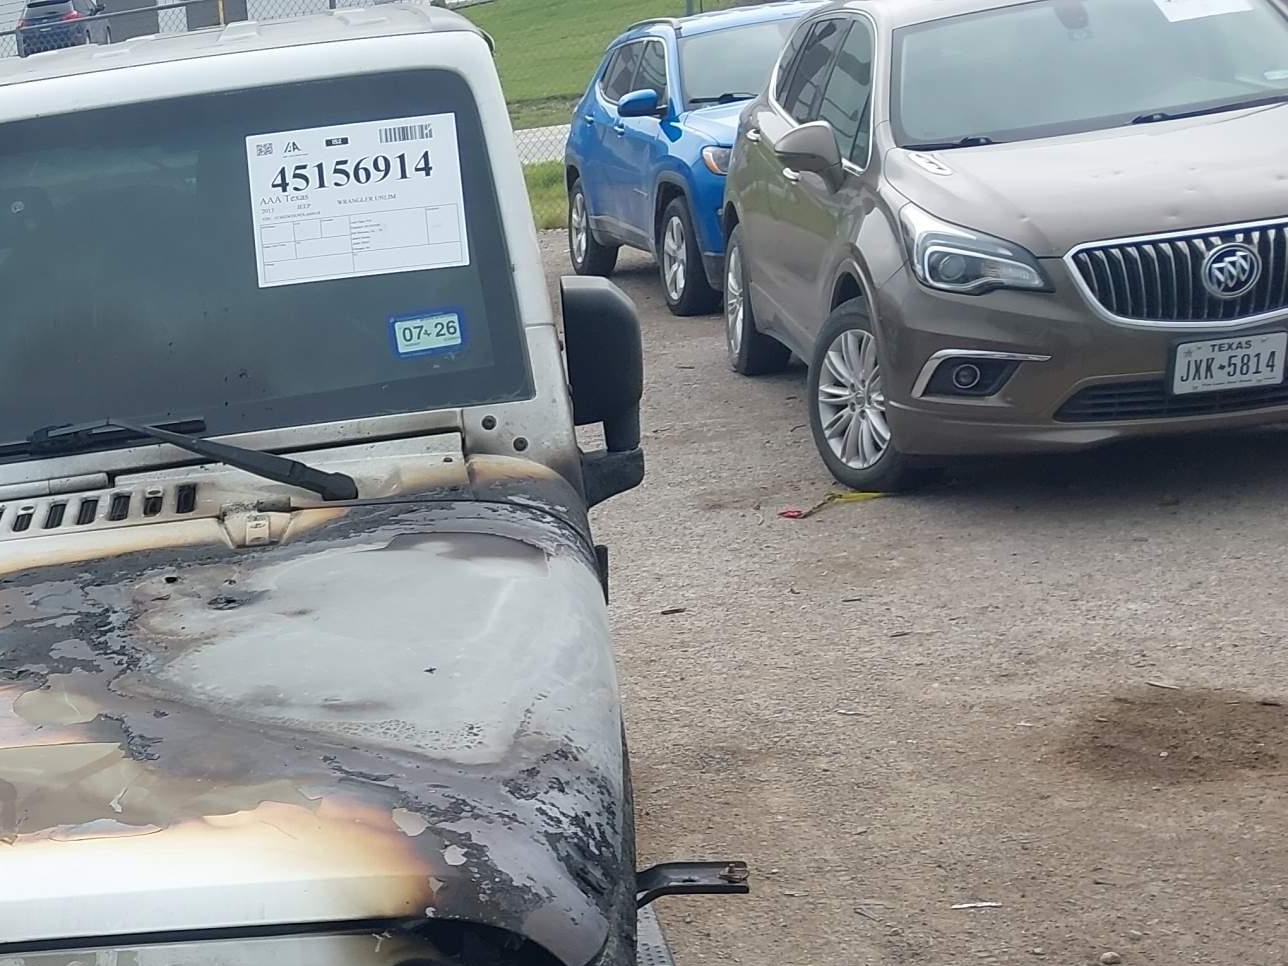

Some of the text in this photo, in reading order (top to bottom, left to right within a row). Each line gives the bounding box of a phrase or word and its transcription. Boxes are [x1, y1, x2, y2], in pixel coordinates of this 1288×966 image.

[271, 150, 433, 193] 45156914
[260, 194, 310, 205] AAA Texas
[402, 320, 457, 342] 07 26
[1210, 340, 1253, 353] TEXAS
